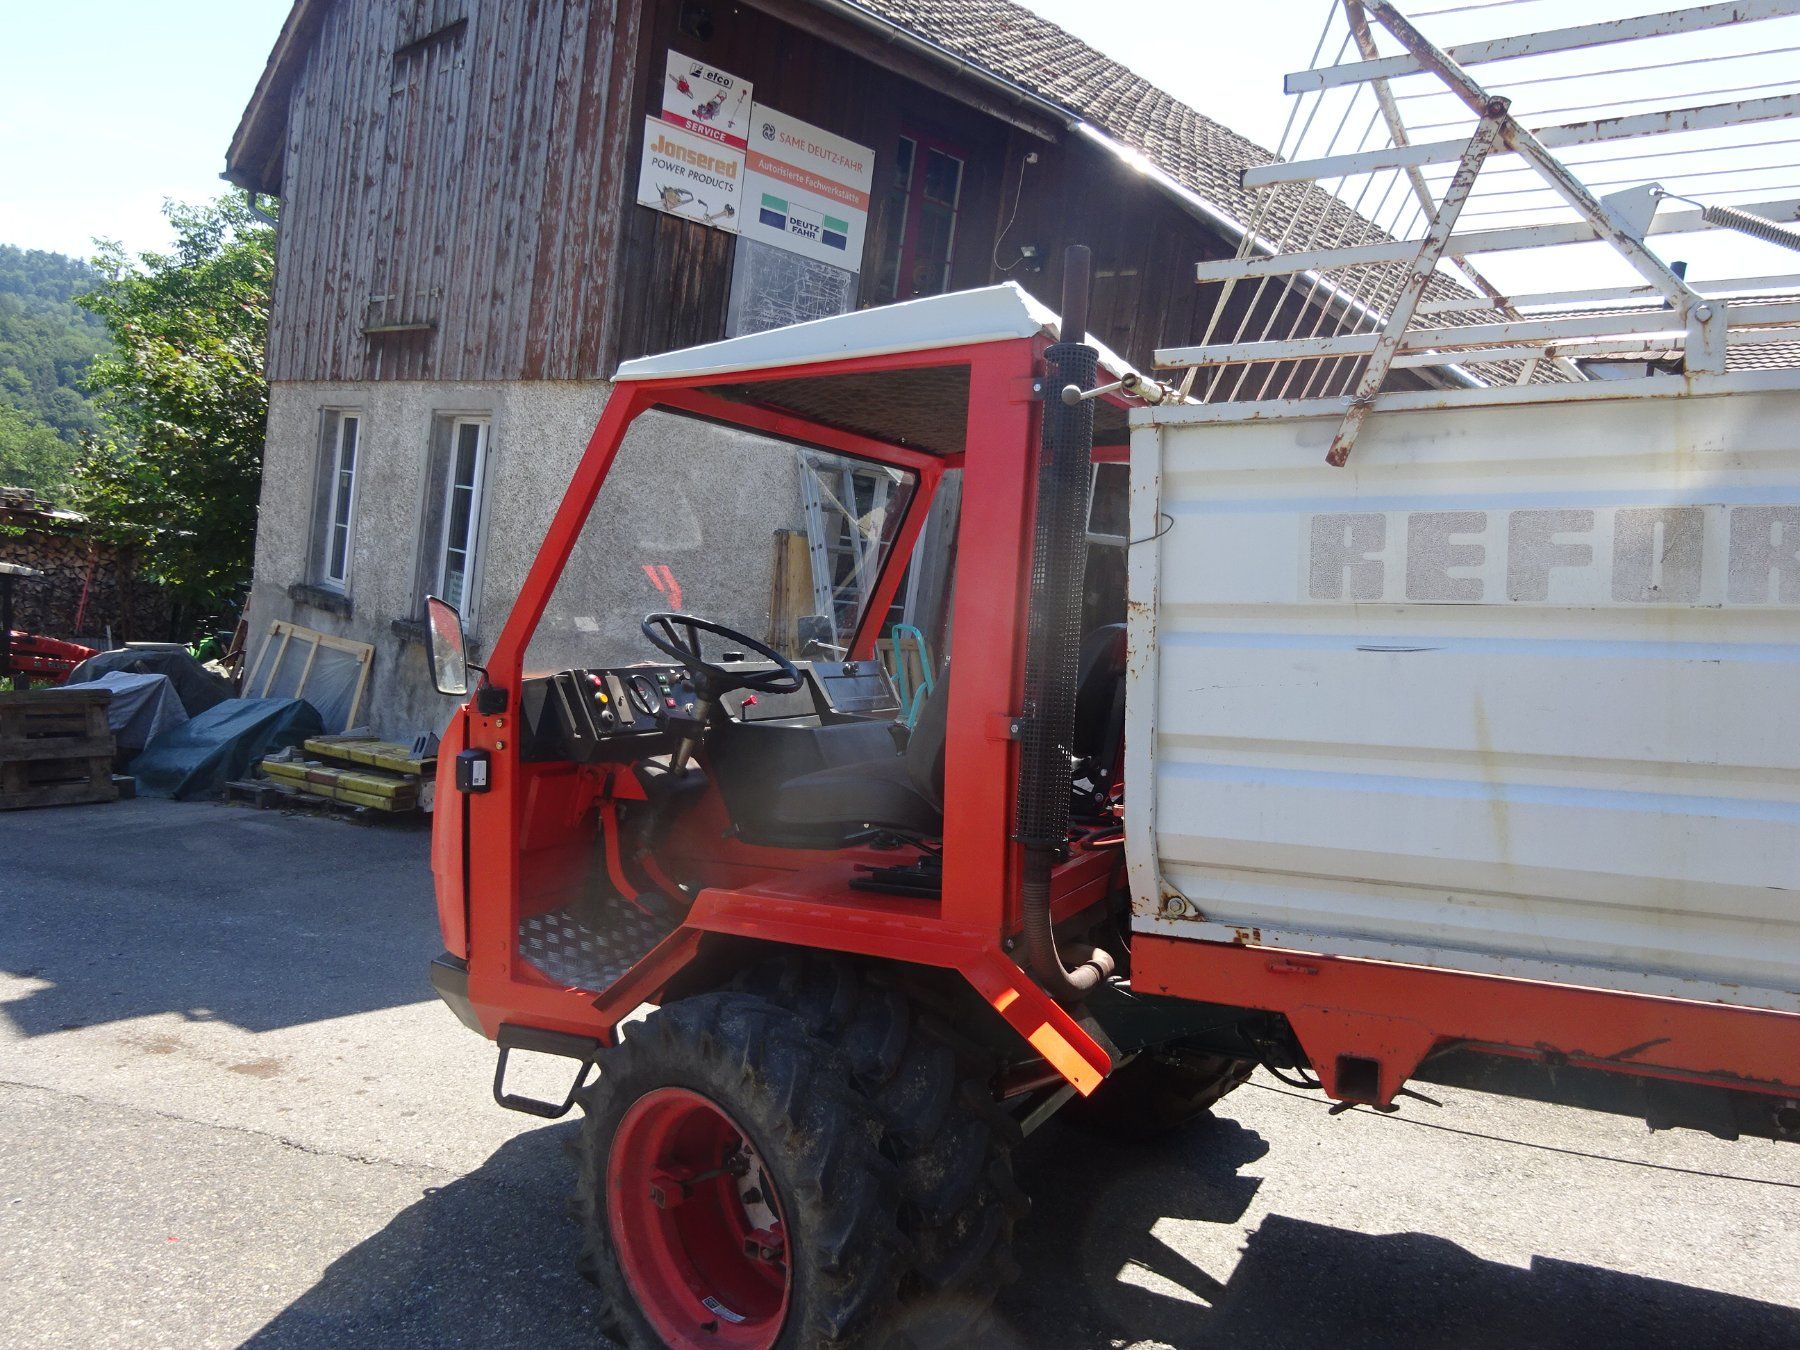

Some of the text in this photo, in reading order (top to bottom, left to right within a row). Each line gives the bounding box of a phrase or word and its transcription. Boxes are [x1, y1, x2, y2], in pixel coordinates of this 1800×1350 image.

[706, 71, 730, 87] efco
[685, 120, 727, 141] SERVICE
[779, 132, 806, 151] SAME
[651, 134, 738, 180] Jonsered
[652, 157, 734, 193] POWER PRODUCTS
[758, 159, 804, 183] Autorisierte
[789, 217, 820, 233] DEUTZ
[792, 226, 816, 239] FAHR
